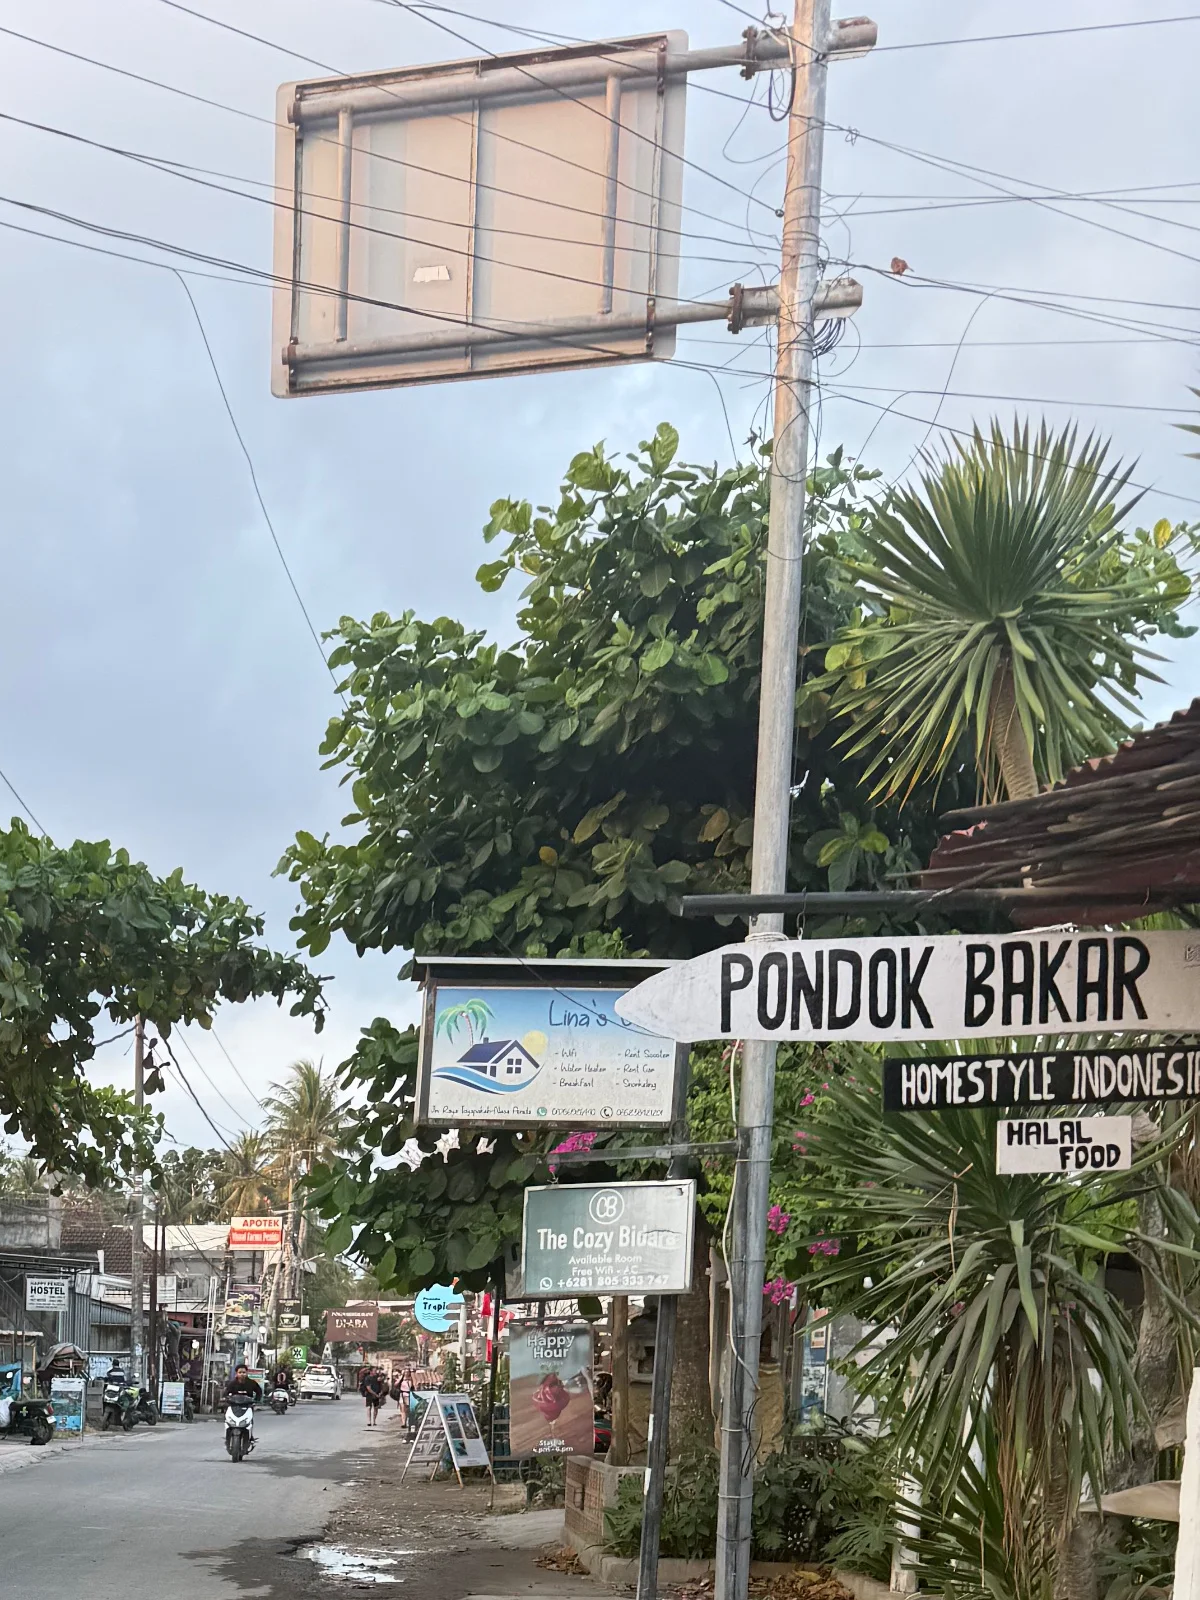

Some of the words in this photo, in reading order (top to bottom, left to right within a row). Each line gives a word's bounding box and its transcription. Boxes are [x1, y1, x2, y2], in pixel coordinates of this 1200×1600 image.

[721, 946, 934, 1033] PONDOK
[964, 937, 1150, 1028] BAKAR
[549, 999, 607, 1027] Lina's
[901, 1056, 1057, 1105] HOMESTYLE
[1006, 1120, 1093, 1146] HALAL
[1059, 1143, 1121, 1170] FOOD
[242, 1219, 280, 1227] APOTEK
[537, 1228, 567, 1250] The
[573, 1227, 614, 1253] Cozy
[568, 1254, 612, 1265] Available
[615, 1253, 642, 1263] Room
[572, 1266, 592, 1277] Free
[595, 1265, 614, 1276] Wifi
[557, 1276, 593, 1288] +6281
[30, 1286, 66, 1295] HOSTEL
[527, 1334, 575, 1348] Happy
[533, 1347, 569, 1359] Hour
